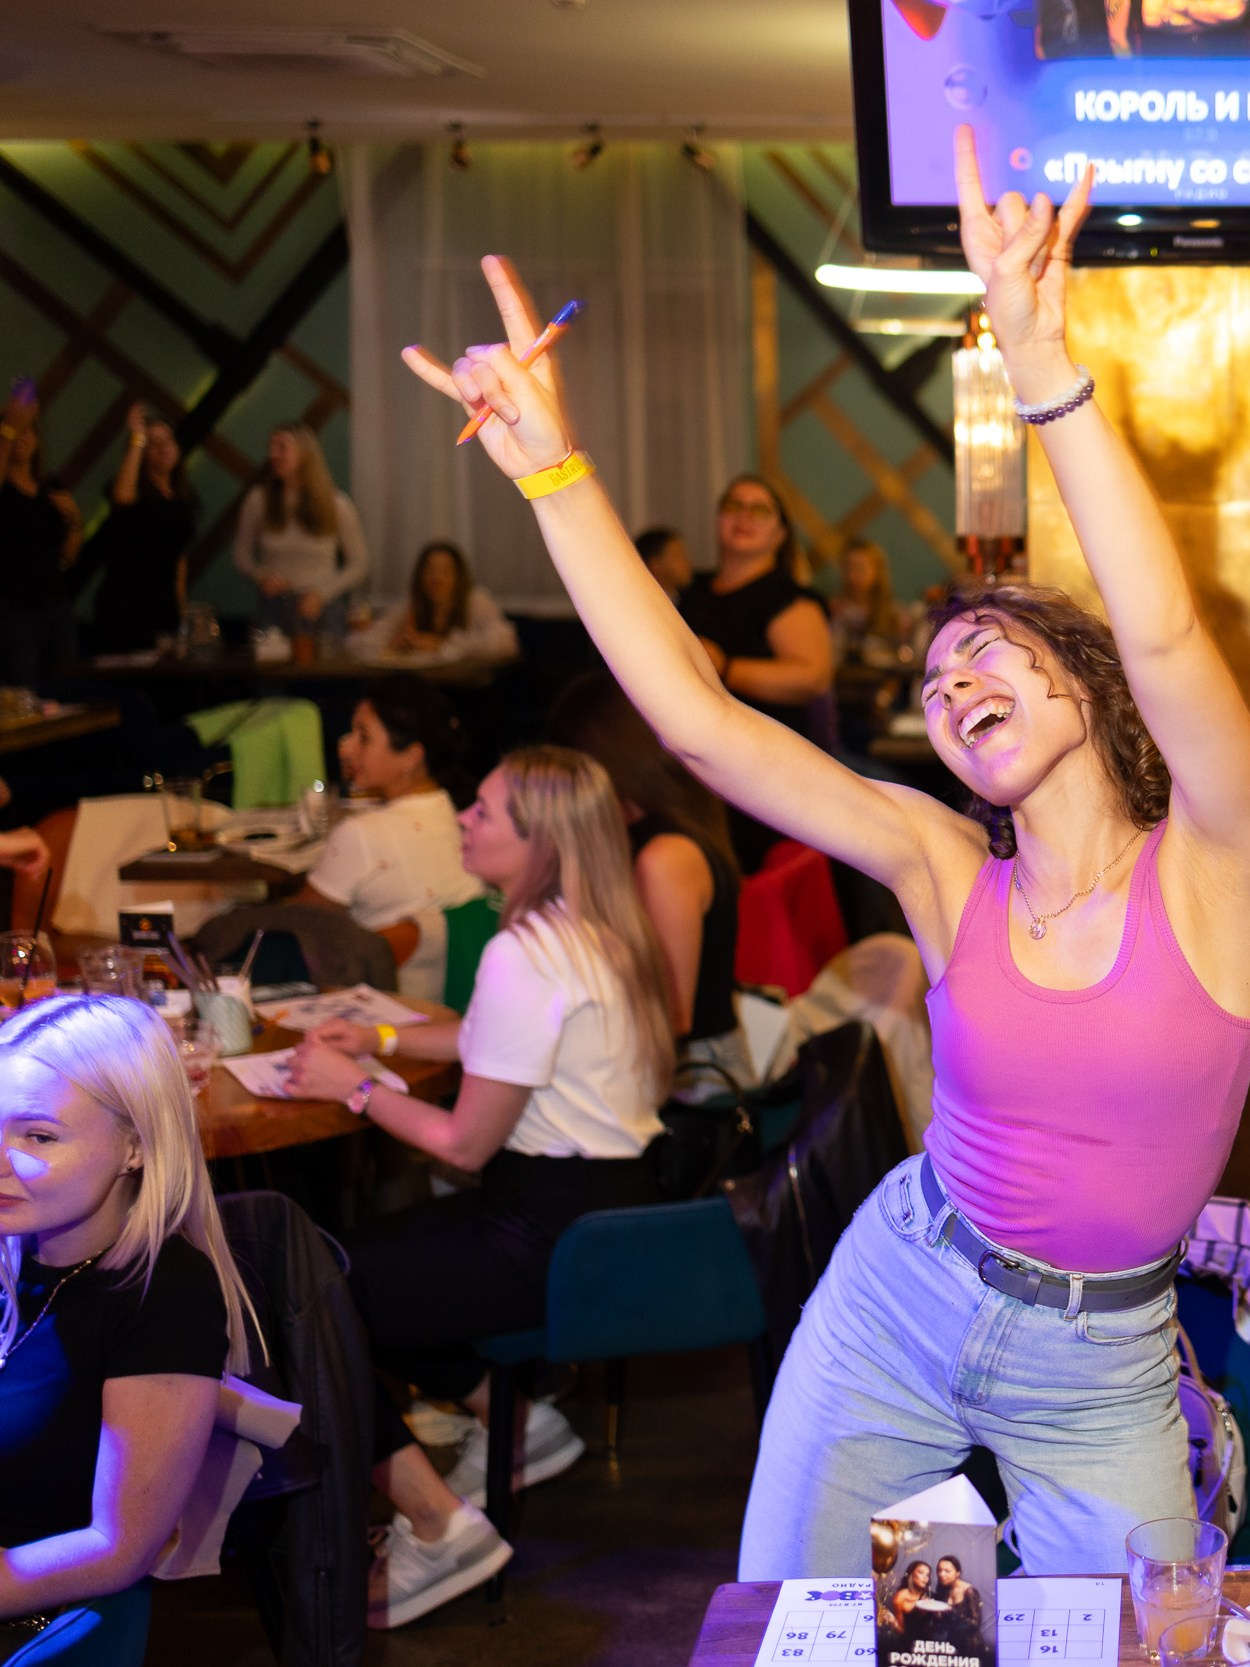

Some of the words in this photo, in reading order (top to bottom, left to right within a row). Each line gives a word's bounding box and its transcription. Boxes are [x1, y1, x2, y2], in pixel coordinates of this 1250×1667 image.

[1075, 90, 1210, 122] КОРОЛЬ
[1215, 90, 1239, 122] И
[1189, 158, 1228, 184] со
[1003, 1613, 1025, 1622] 29
[1083, 1613, 1093, 1621] 2
[786, 1632, 809, 1640] 86
[825, 1630, 847, 1639] 79
[1040, 1629, 1058, 1637] 13
[913, 1639, 956, 1654] ДЕНЬ
[1039, 1645, 1059, 1654] 16
[781, 1648, 804, 1657] 83
[854, 1647, 876, 1656] 60
[889, 1652, 980, 1667] РОЖДЕНИЯ
